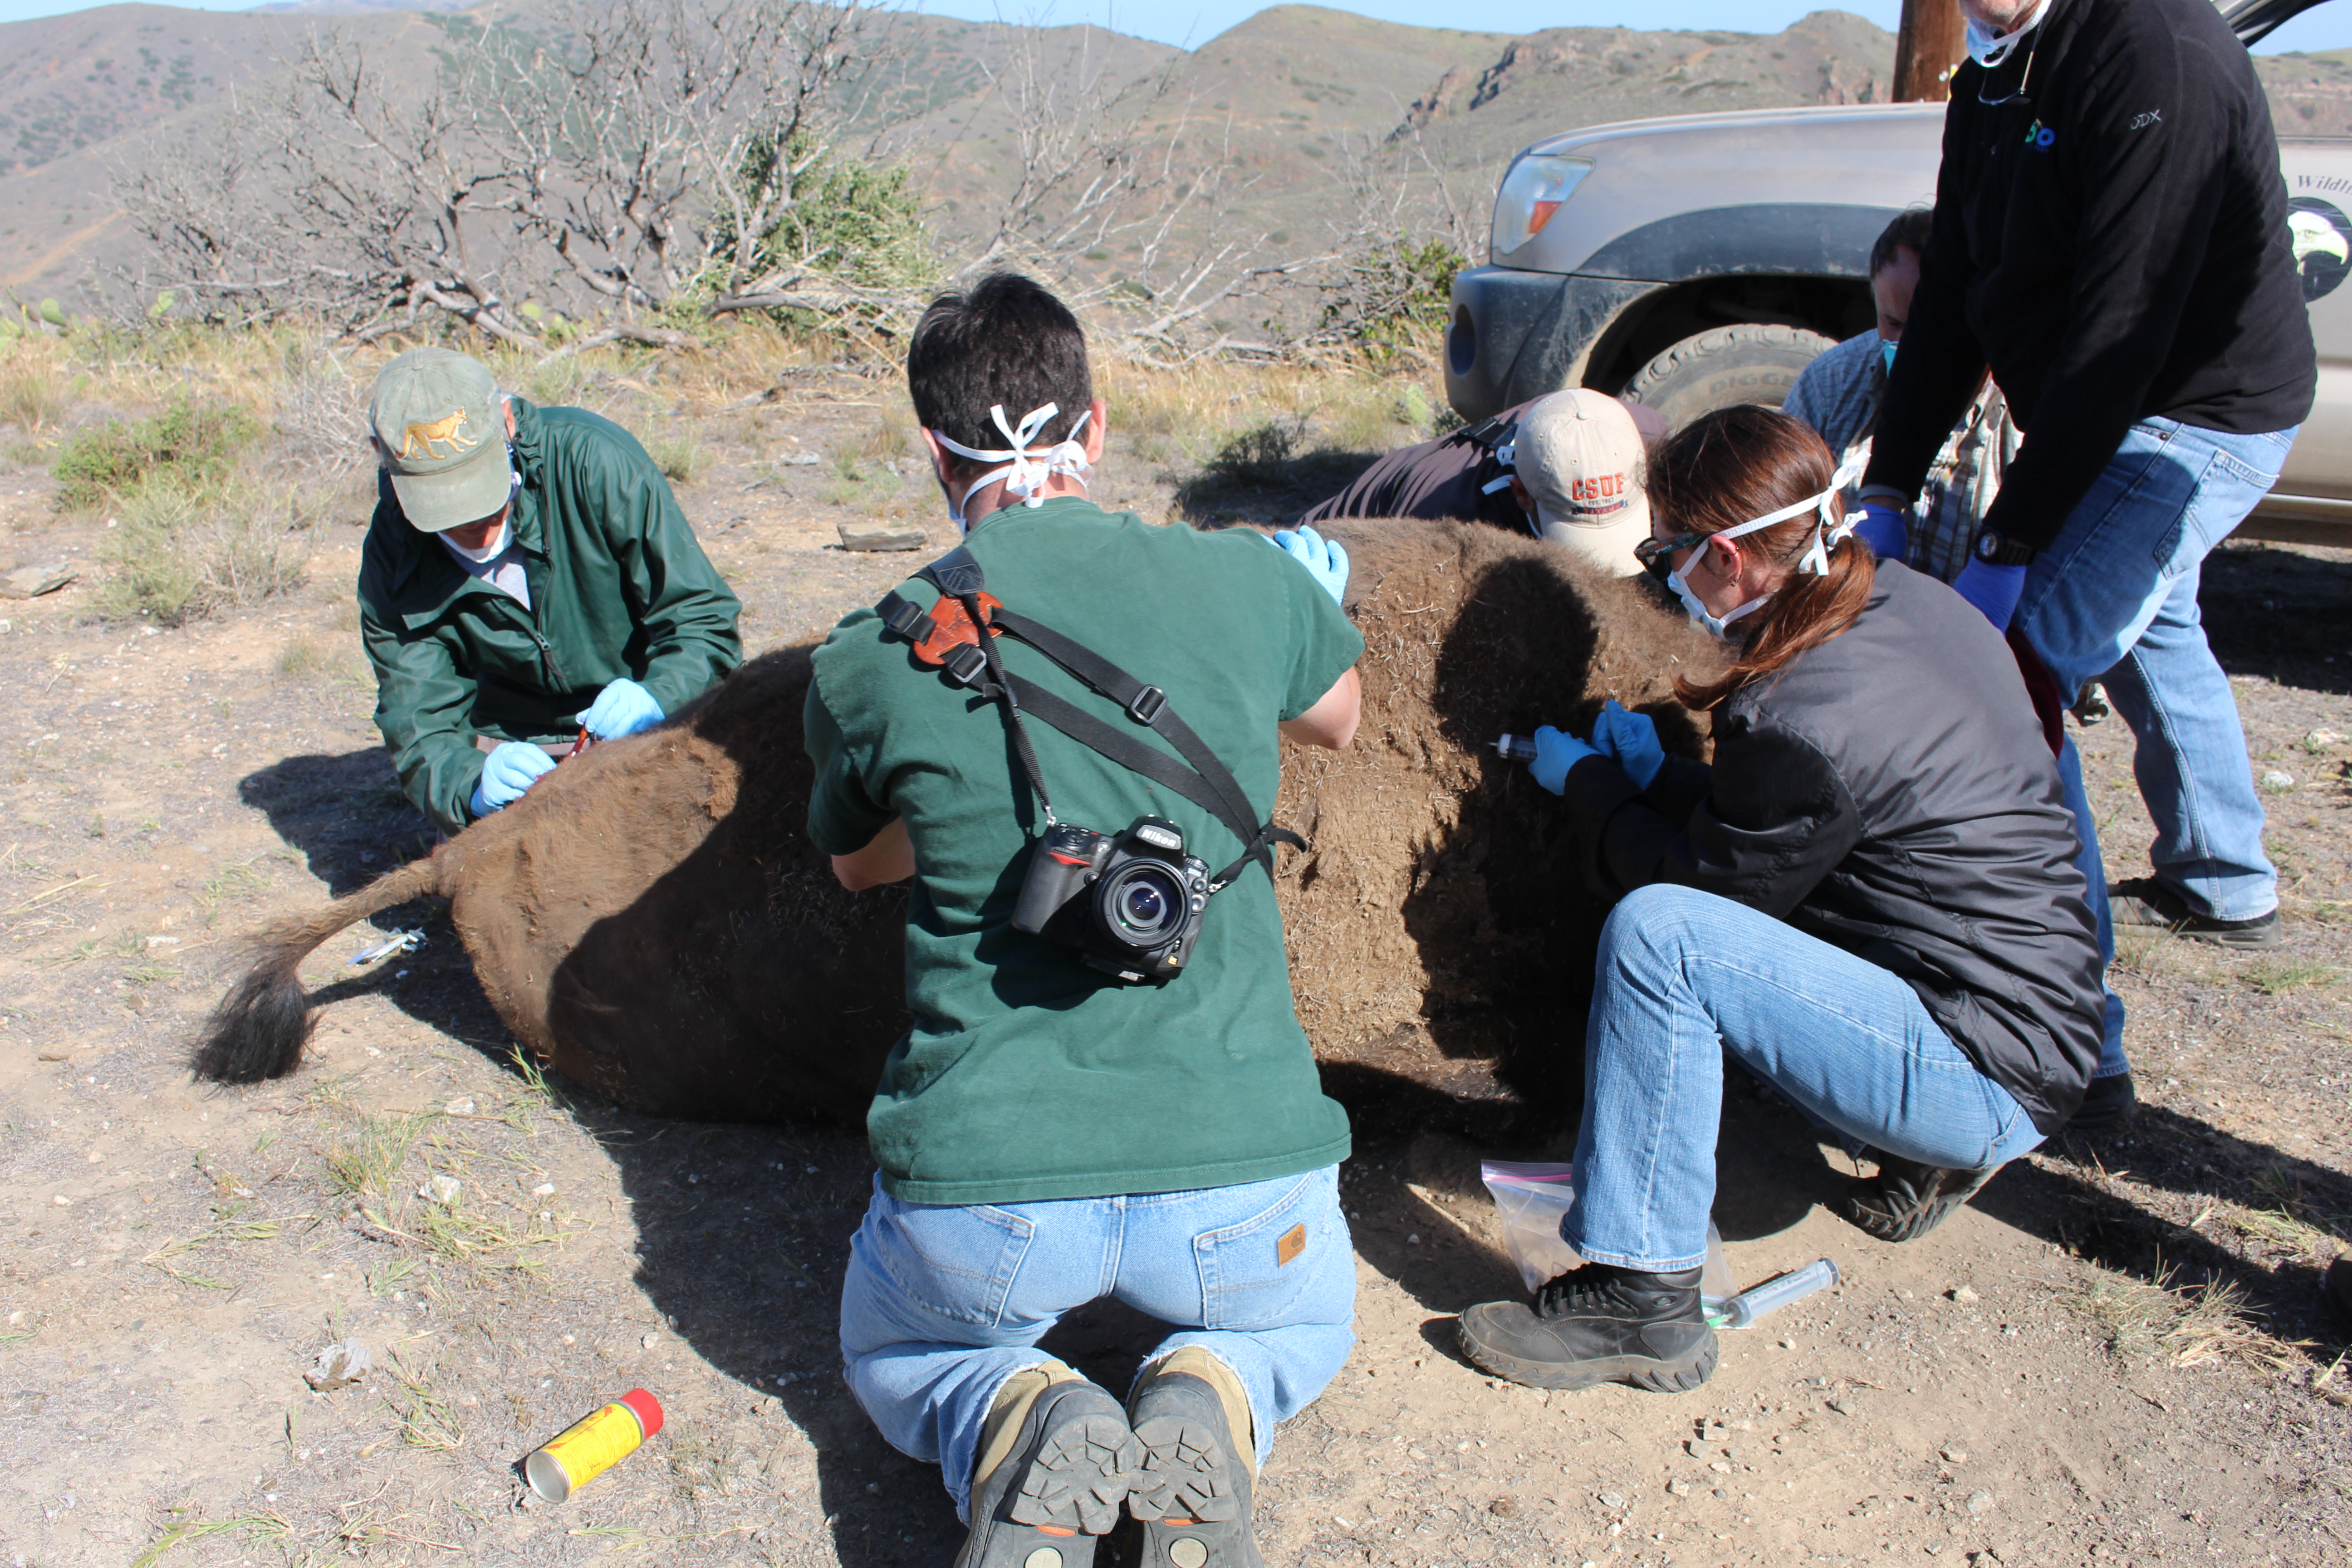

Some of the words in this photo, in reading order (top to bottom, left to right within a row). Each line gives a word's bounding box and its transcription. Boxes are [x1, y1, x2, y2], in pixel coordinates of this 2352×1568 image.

[2130, 109, 2162, 130] JDX
[2298, 175, 2352, 195] Wildli
[1572, 472, 1625, 500] CSUF
[1583, 502, 1621, 514] TITANS
[1141, 829, 1177, 847] Nikon
